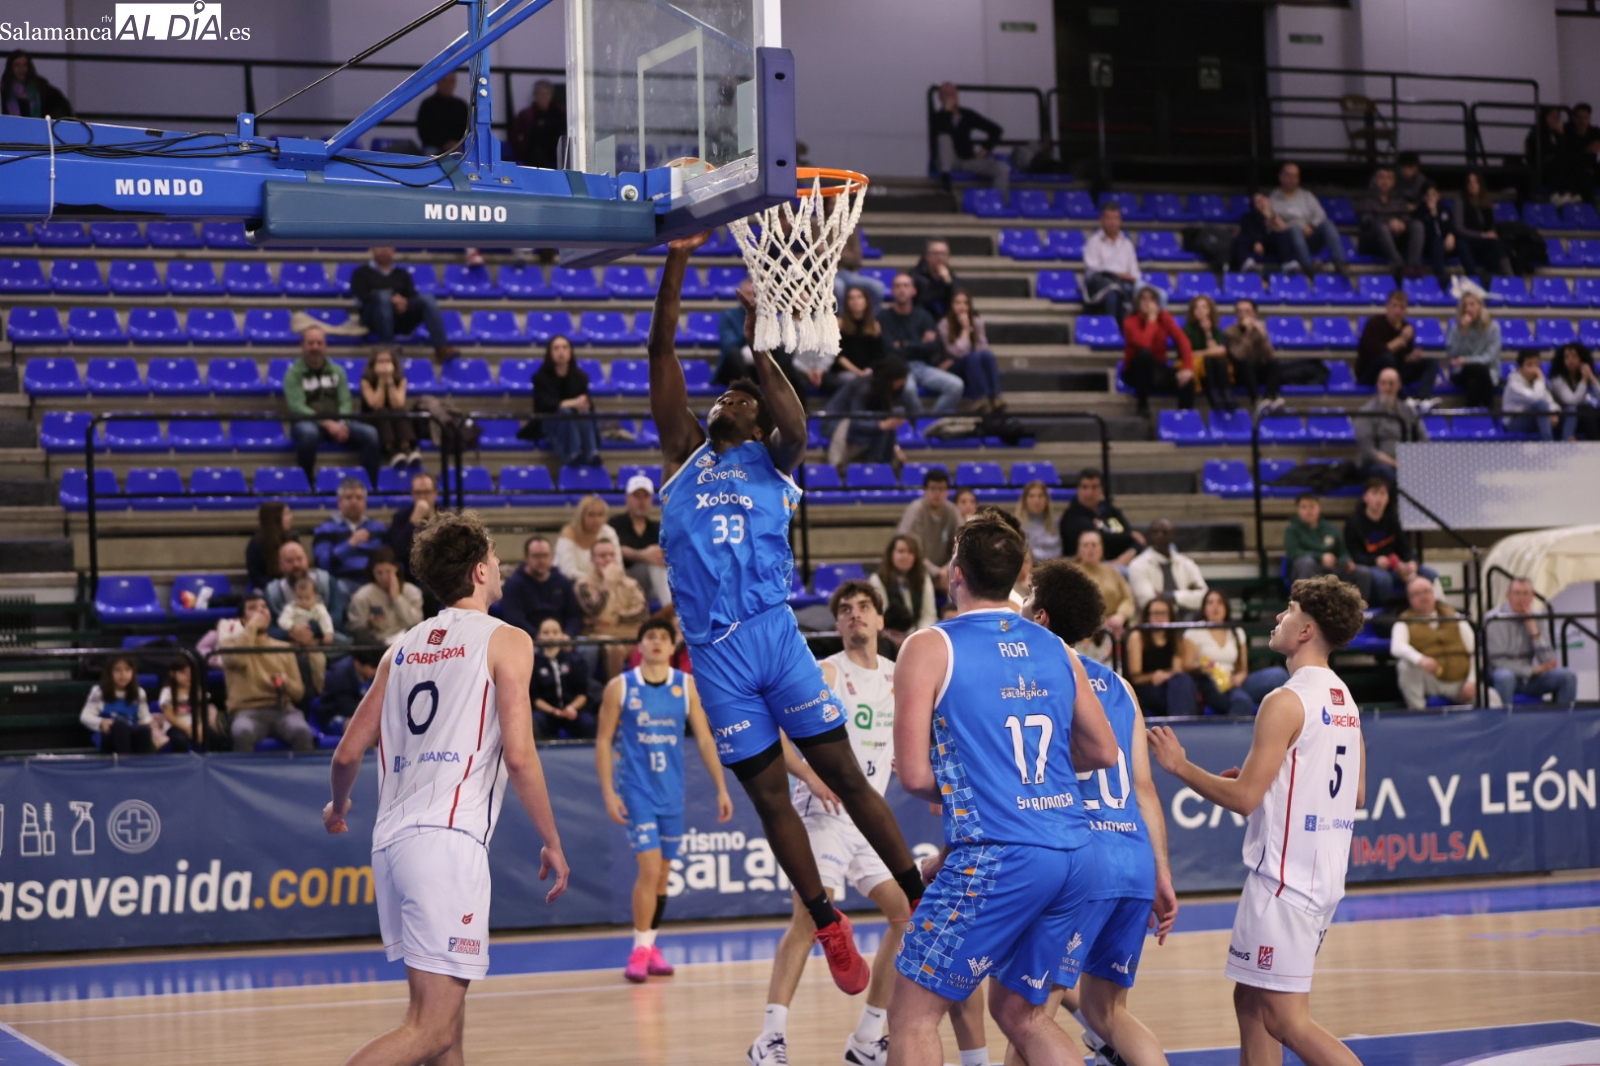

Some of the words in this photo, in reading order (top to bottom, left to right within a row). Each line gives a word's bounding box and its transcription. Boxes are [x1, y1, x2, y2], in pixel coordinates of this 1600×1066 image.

[115, 178, 204, 196] MONDO
[424, 203, 508, 223] MONDO
[711, 514, 744, 544] 33
[998, 641, 1030, 658] ROA
[407, 680, 439, 735] 0
[649, 751, 667, 772] 13
[1004, 714, 1054, 785] 17
[1329, 745, 1347, 799] 5
[1428, 775, 1461, 827] Y
[1480, 756, 1597, 815] LEÓN
